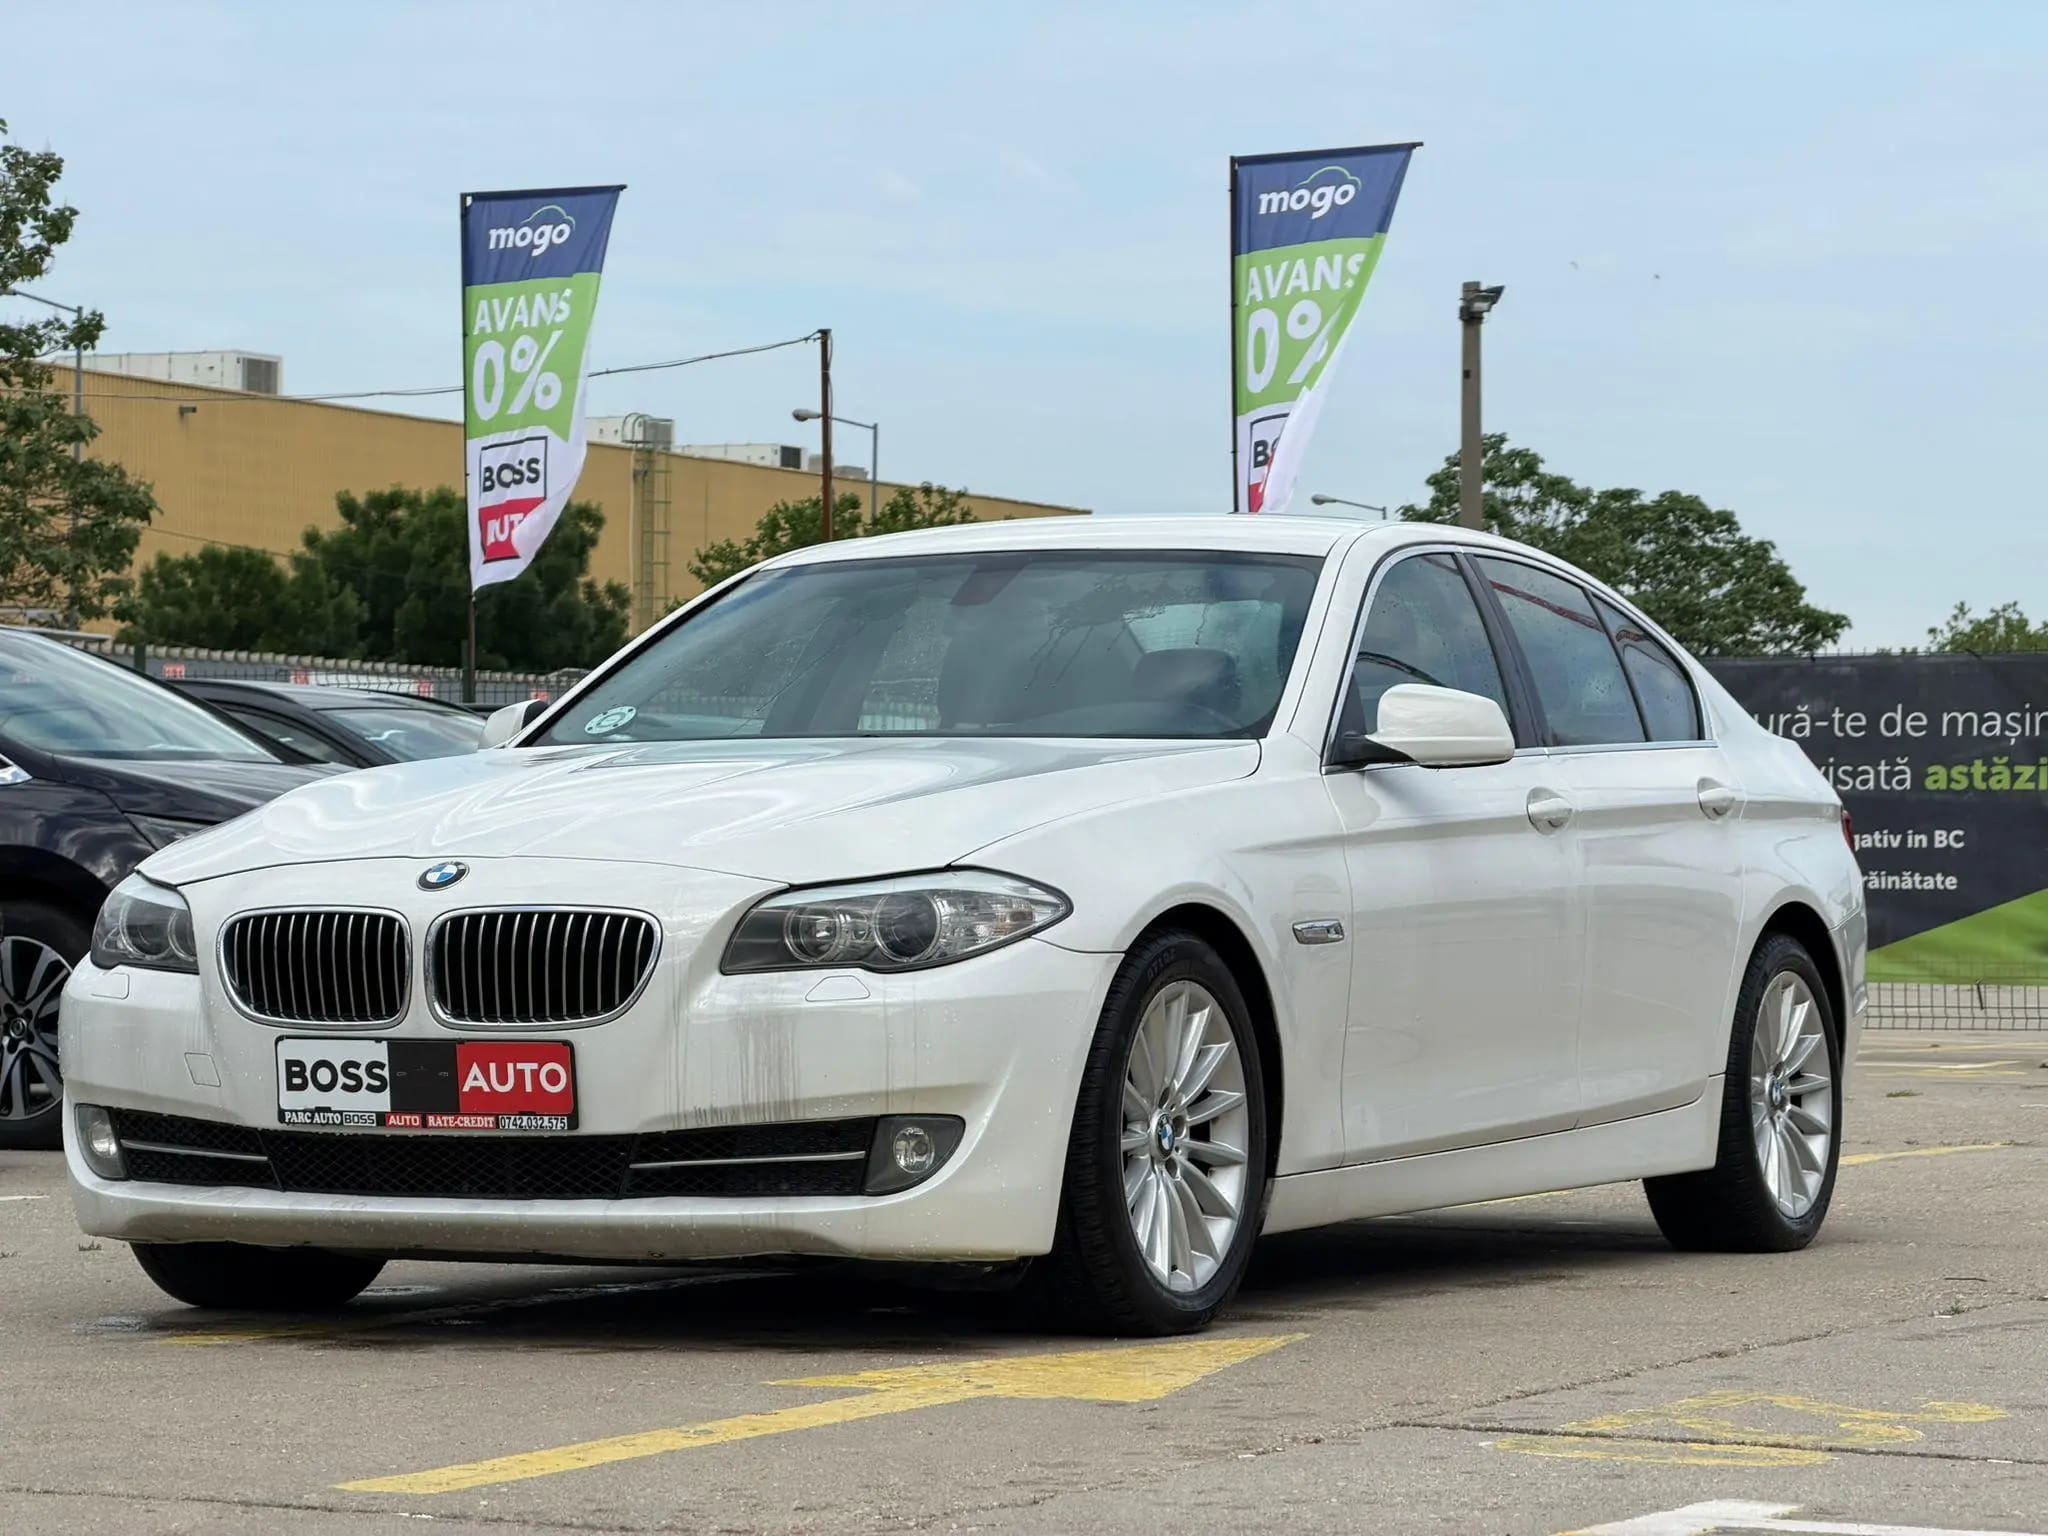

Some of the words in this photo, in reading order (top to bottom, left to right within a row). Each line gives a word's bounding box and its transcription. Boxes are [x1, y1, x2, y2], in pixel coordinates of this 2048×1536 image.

[1259, 183, 1356, 220] mogo
[488, 221, 572, 256] mogo
[473, 288, 572, 335] AVANS
[473, 330, 563, 421] 0%
[1879, 703, 1928, 738] de
[1924, 756, 2048, 790] astăzi
[1906, 829, 1928, 848] in
[1933, 829, 1965, 849] BC
[284, 1059, 388, 1093] BOSS
[462, 1061, 567, 1093] AUTO
[284, 1111, 312, 1124] PARC
[313, 1112, 341, 1124] AUTO
[344, 1113, 376, 1125] BOSS
[388, 1115, 420, 1126] AUTO
[428, 1115, 496, 1128] RATE-CREDIT
